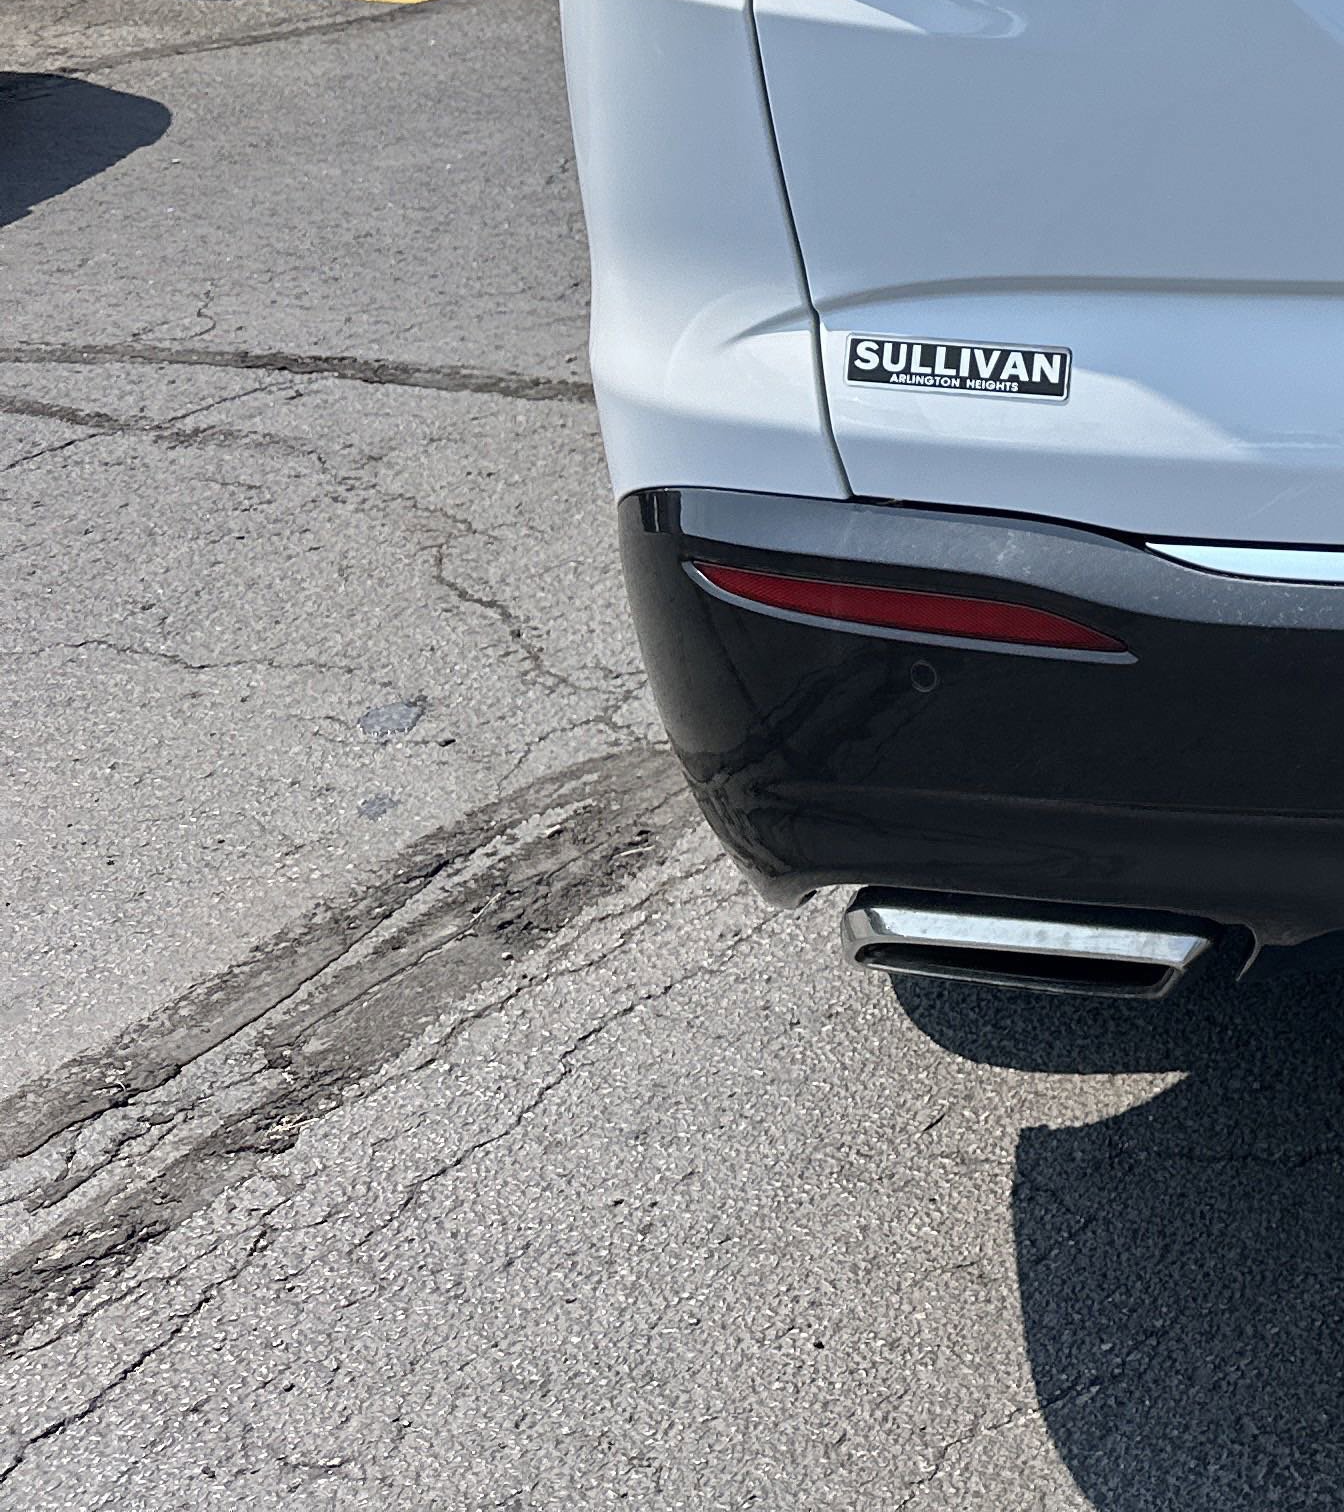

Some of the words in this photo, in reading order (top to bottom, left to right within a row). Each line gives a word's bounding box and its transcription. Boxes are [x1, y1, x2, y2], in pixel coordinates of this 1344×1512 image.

[853, 340, 1062, 384] SULLIVAN
[889, 372, 960, 388] ARLINGTON
[966, 379, 1019, 393] HEIGHTS
